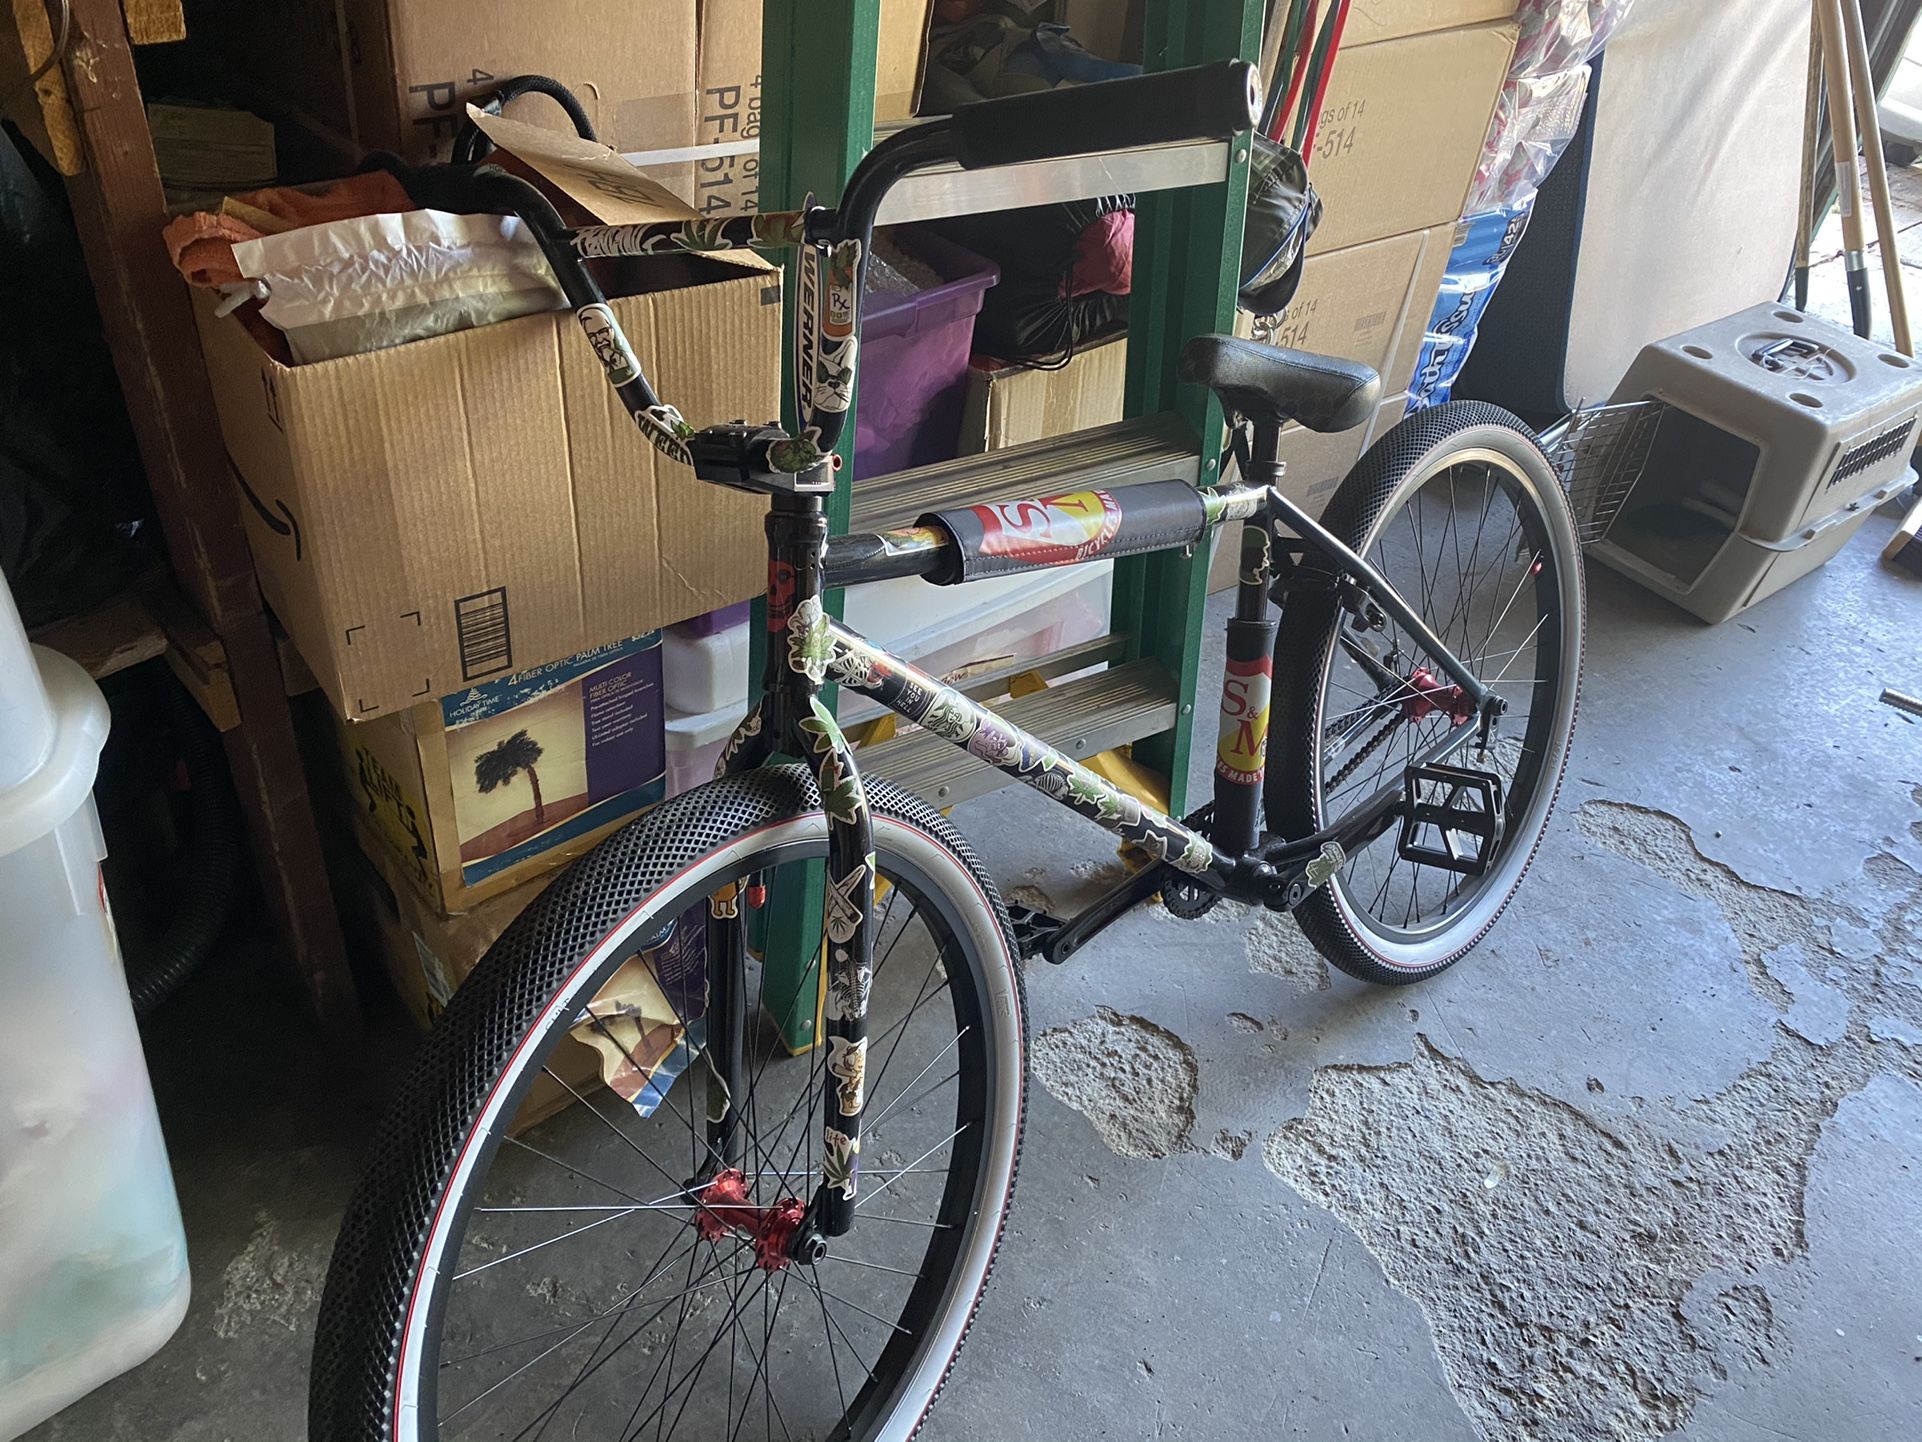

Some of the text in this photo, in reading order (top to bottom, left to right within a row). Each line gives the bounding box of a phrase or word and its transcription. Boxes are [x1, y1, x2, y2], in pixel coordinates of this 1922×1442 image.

[467, 68, 494, 85] 4
[408, 82, 457, 159] PF-
[740, 97, 761, 139] bag
[1319, 99, 1366, 129] gs of 14
[1292, 299, 1318, 319] of 14
[802, 249, 817, 409] WERNER
[518, 667, 543, 683] FIBER
[545, 656, 573, 673] OPTIC
[575, 647, 601, 662] PALM
[906, 689, 920, 702] YOU
[909, 682, 923, 696] SEE
[450, 695, 500, 718] HOLIDAY TIME
[905, 696, 913, 706] IN
[1221, 679, 1269, 758] S & M
[1228, 771, 1260, 783] MADE
[826, 1128, 847, 1148] life
